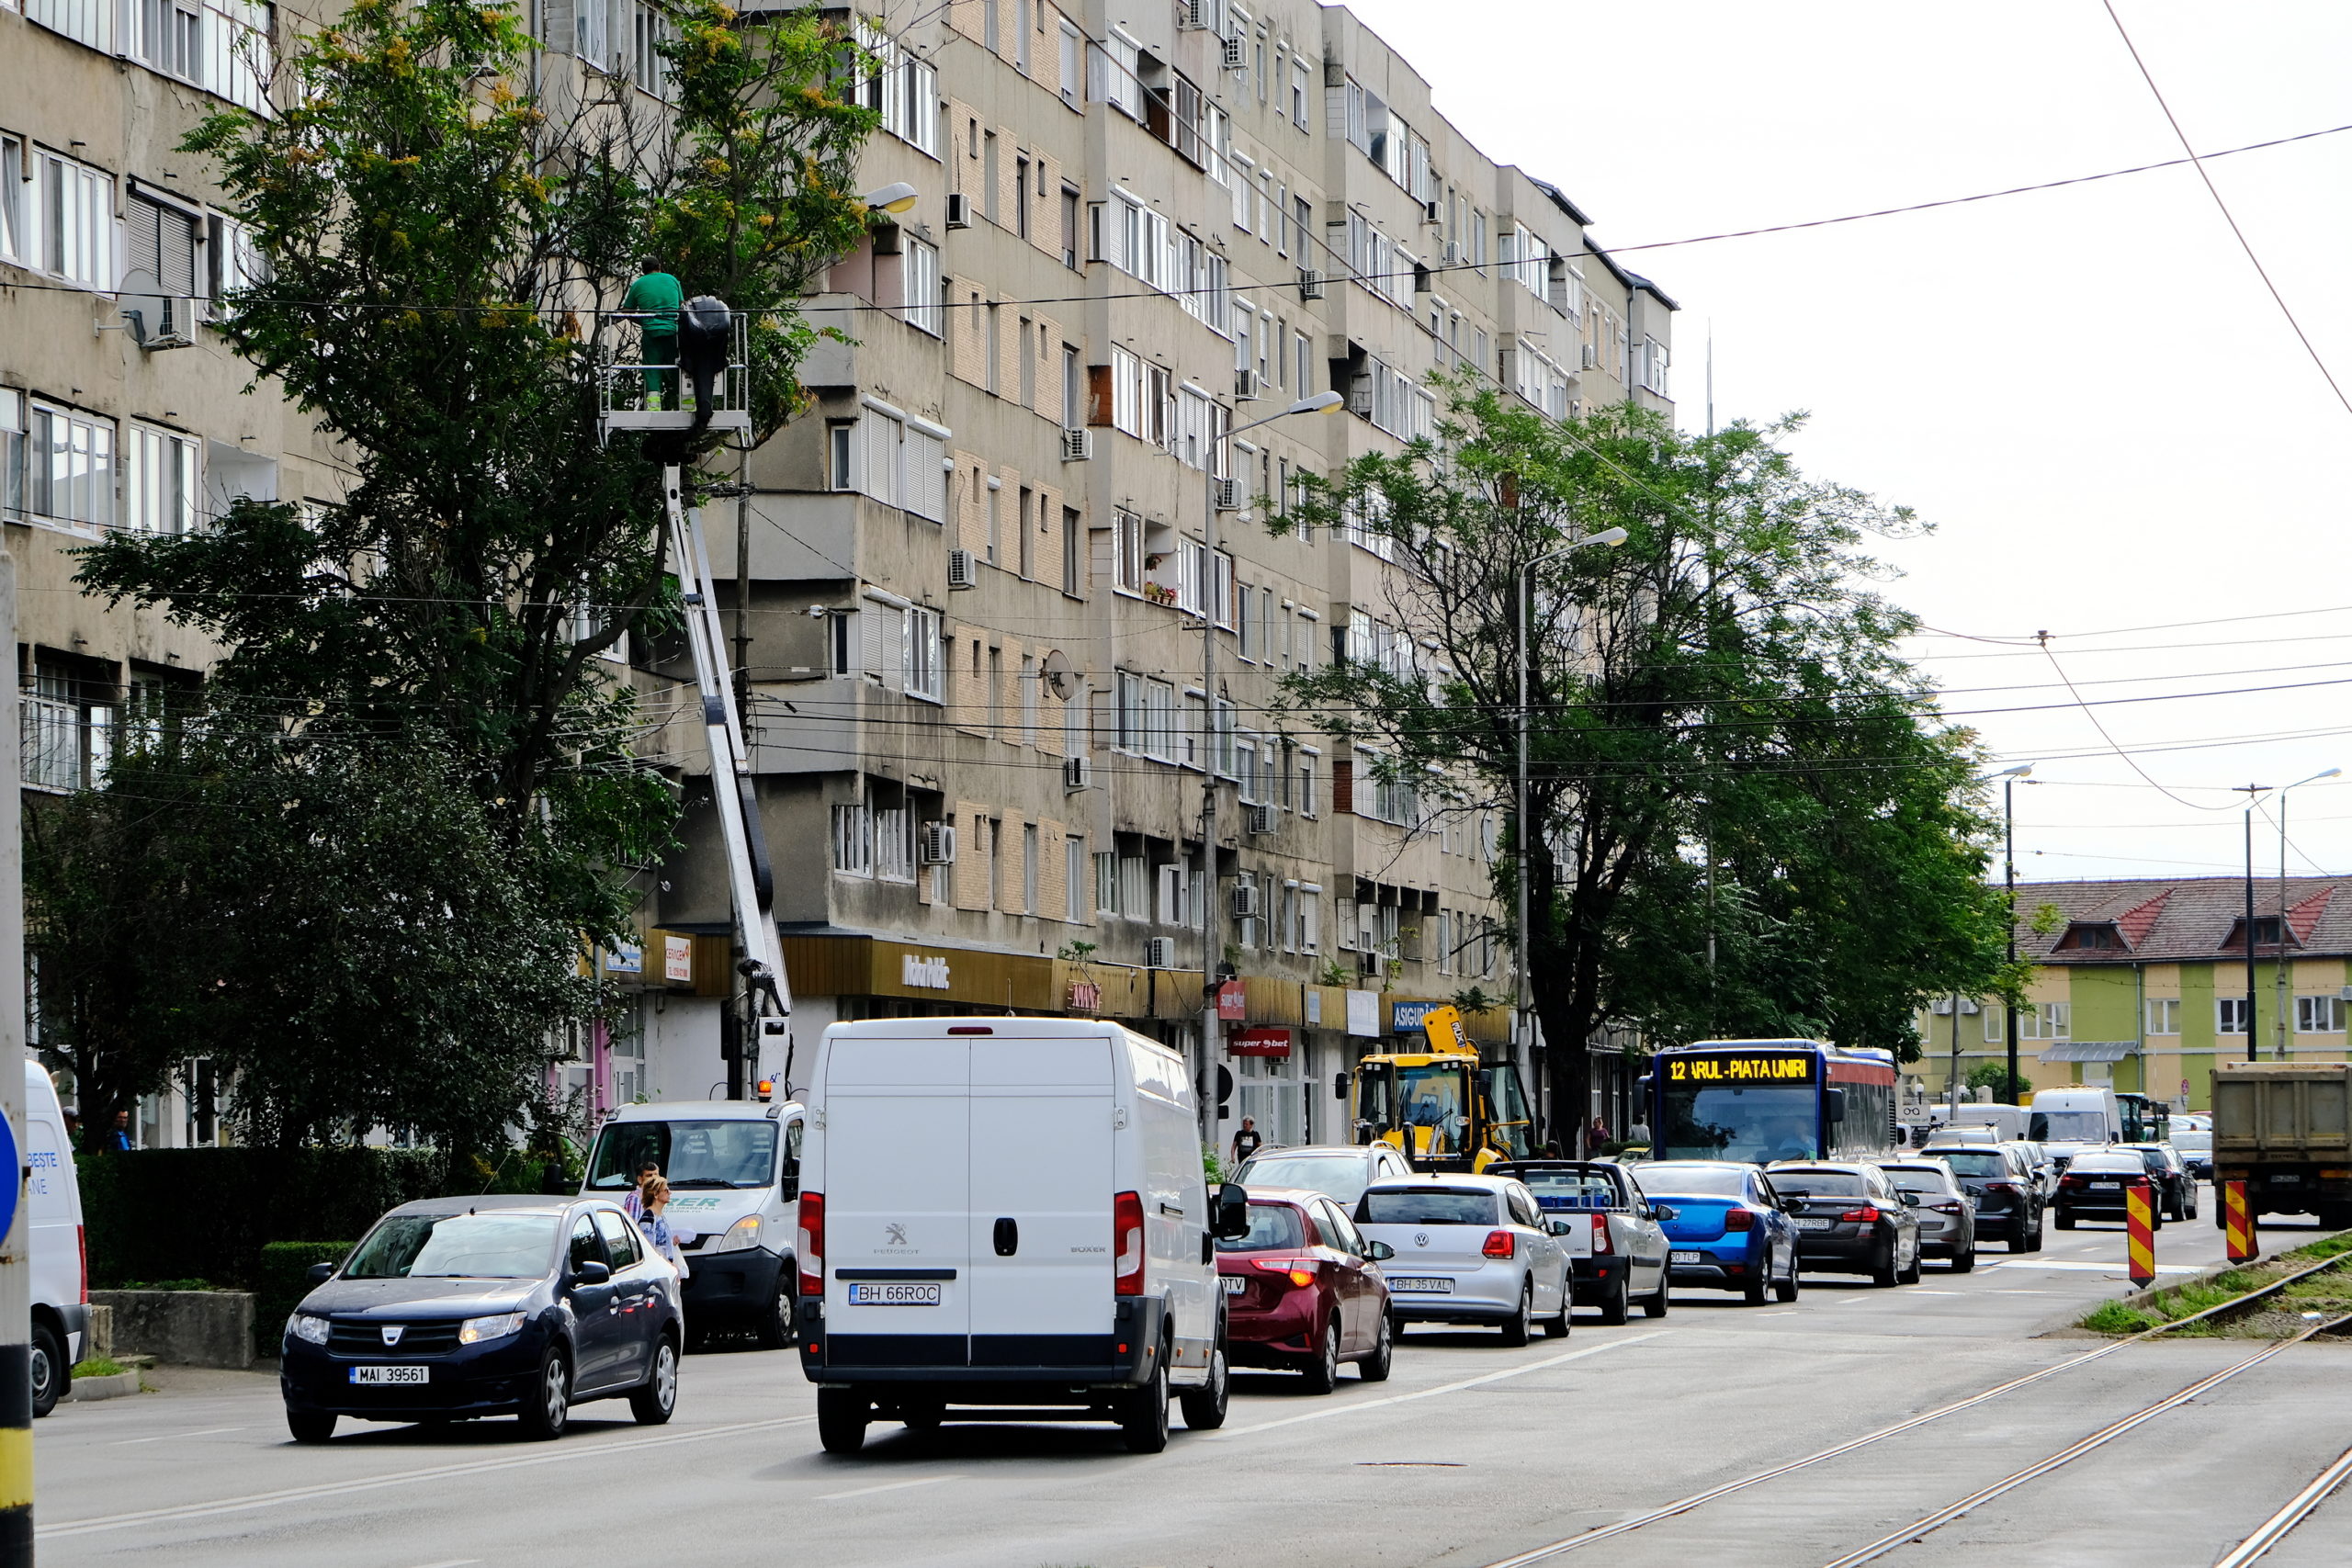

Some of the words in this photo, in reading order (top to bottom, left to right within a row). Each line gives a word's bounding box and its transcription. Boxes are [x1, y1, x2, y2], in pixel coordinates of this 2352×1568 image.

[1670, 1061, 1686, 1080] 12
[1772, 1059, 1806, 1078] UNIRI
[1683, 1253, 1699, 1261] TLP
[1396, 1280, 1412, 1290] BH
[1415, 1280, 1427, 1290] 35
[1429, 1280, 1449, 1291] VAL
[859, 1286, 881, 1301] BH
[887, 1286, 937, 1301] 66ROC
[359, 1368, 380, 1382] MAI
[386, 1368, 424, 1382] 39561
